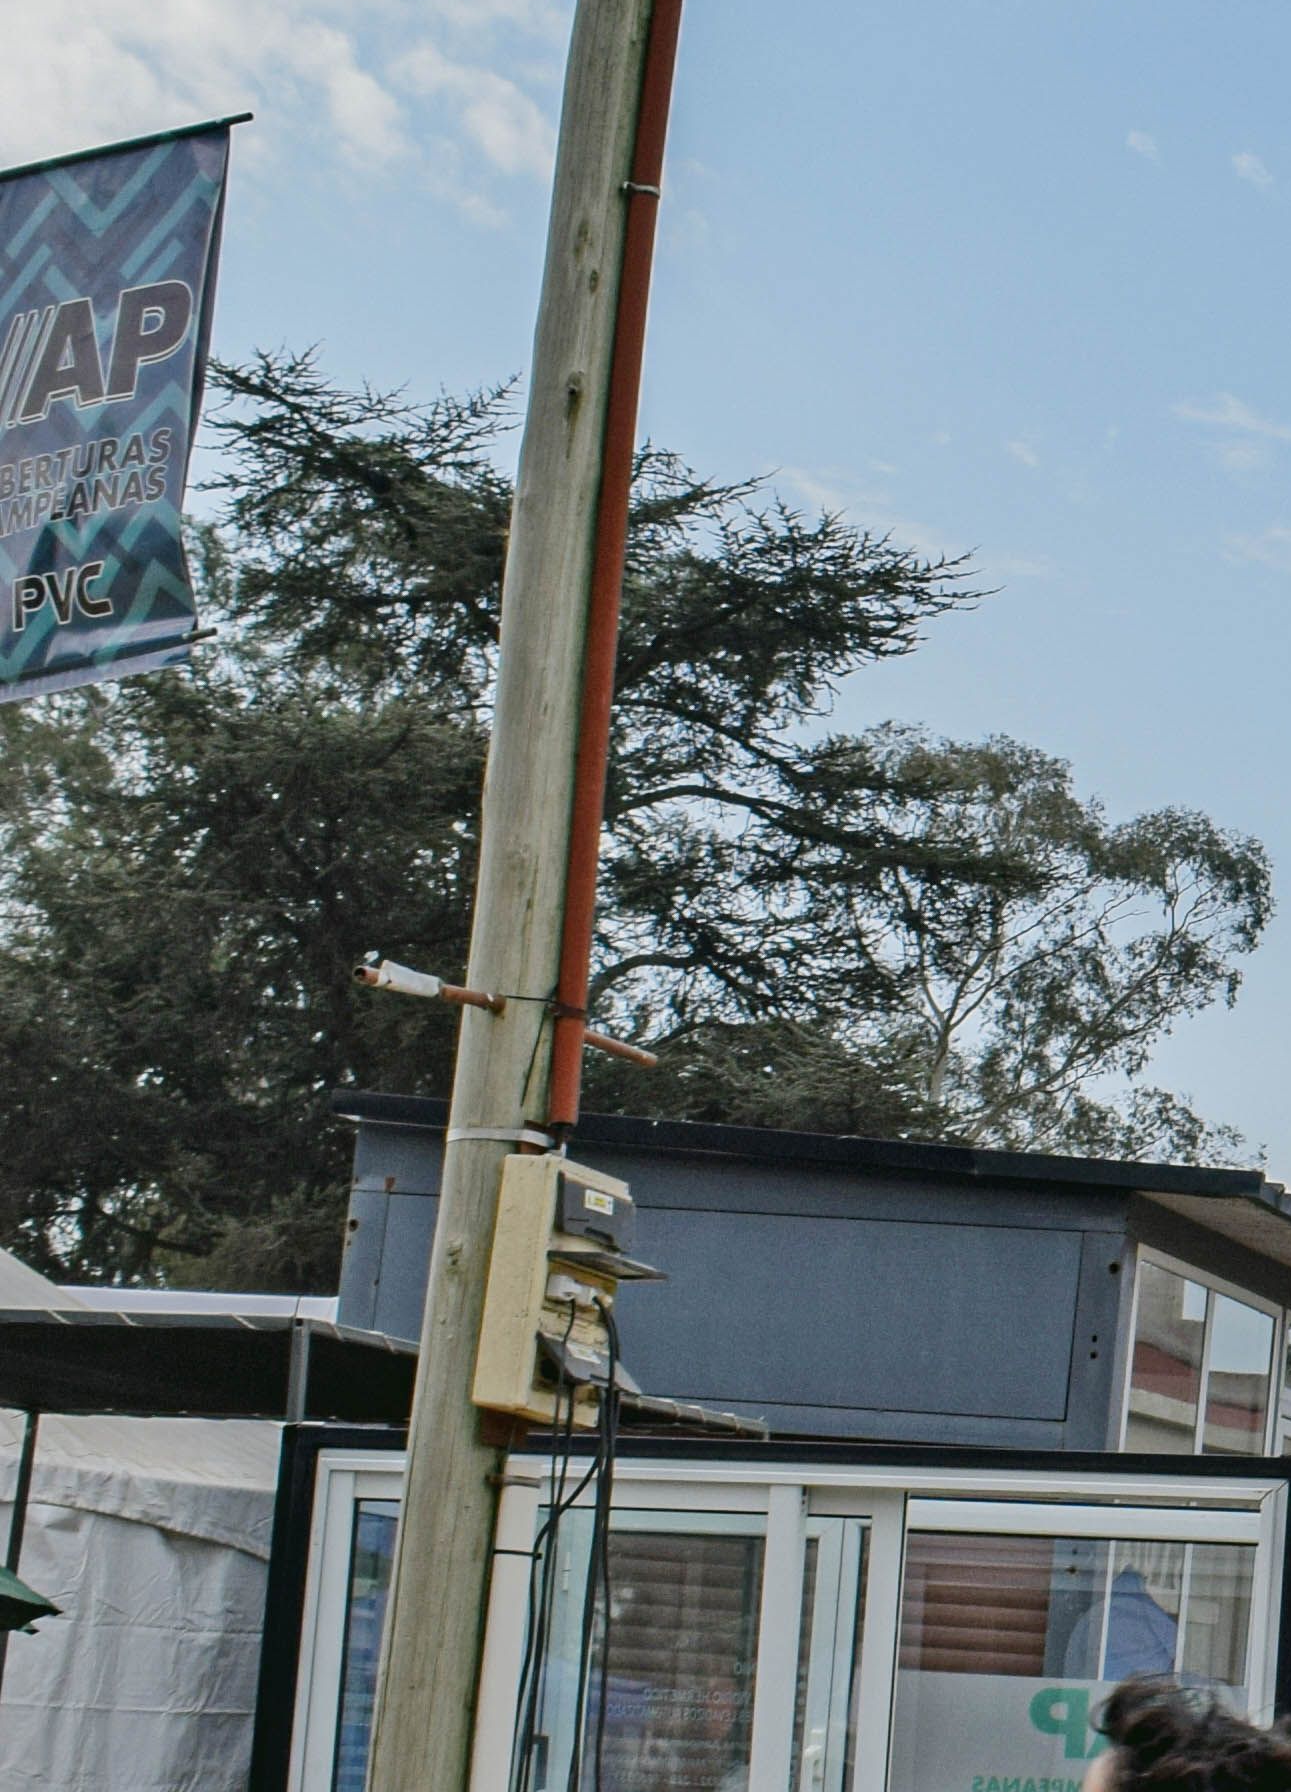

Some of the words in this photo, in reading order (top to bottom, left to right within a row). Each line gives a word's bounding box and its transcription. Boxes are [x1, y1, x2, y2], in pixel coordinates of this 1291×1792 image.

[0, 427, 171, 502] BERTURAS
[0, 465, 167, 538] MPEANAS
[12, 560, 114, 632] PVC
